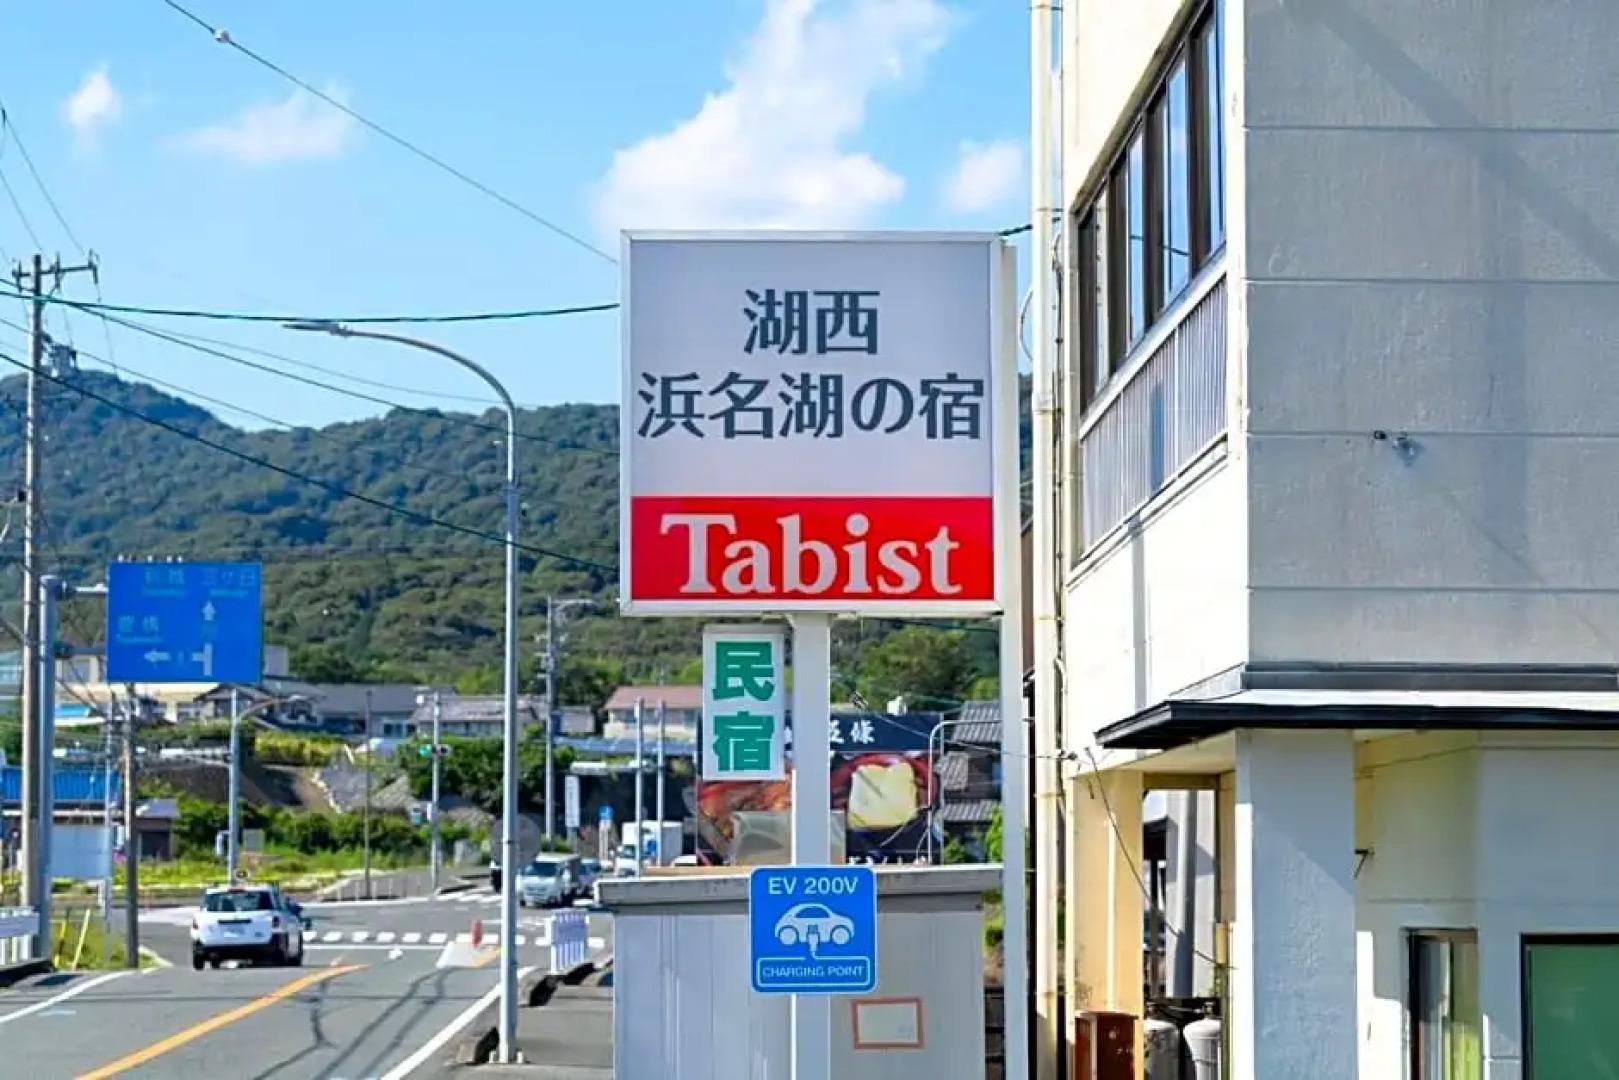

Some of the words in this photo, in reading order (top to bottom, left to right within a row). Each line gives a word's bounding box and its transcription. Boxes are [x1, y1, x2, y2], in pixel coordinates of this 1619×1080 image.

[743, 288, 880, 355] 湖西
[637, 371, 985, 439] 浜名湖の宿
[660, 513, 962, 595] Tabist
[712, 641, 775, 771] 民宿
[767, 877, 797, 895] EV
[803, 877, 859, 895] 200V
[762, 965, 825, 978] CHARGING
[827, 965, 865, 977] POINT
